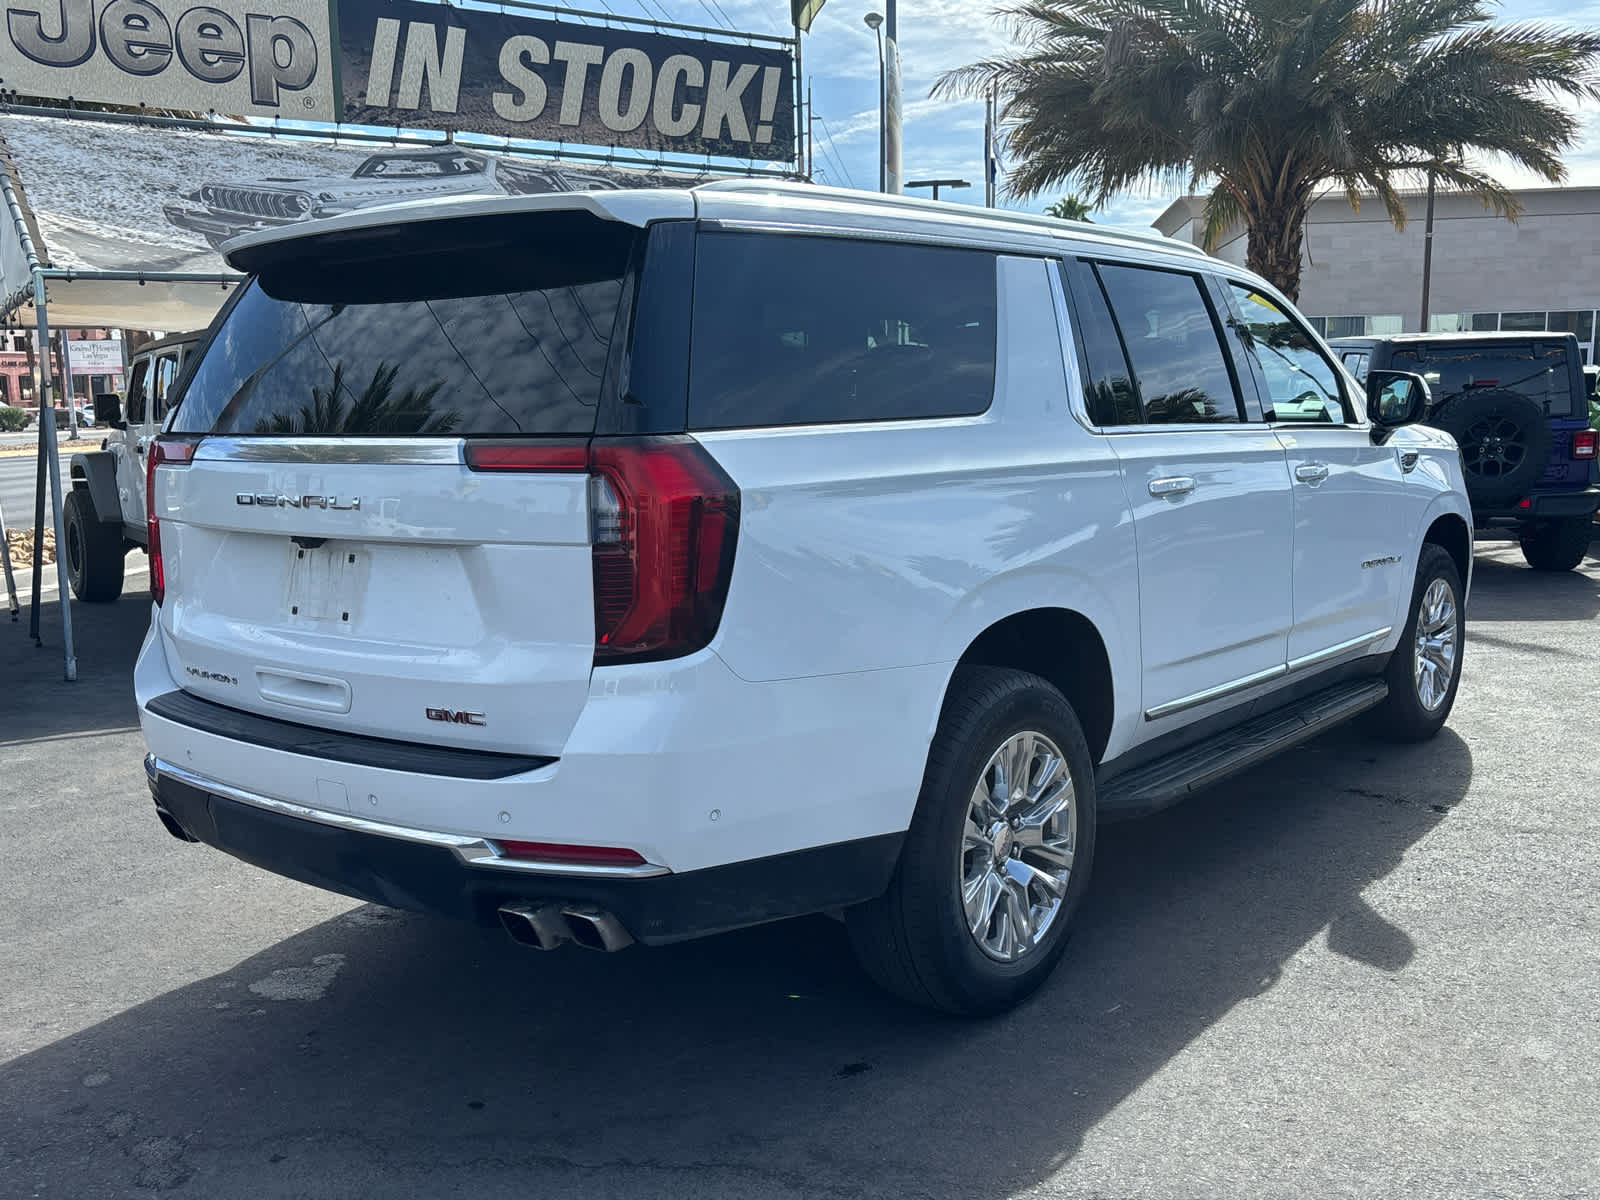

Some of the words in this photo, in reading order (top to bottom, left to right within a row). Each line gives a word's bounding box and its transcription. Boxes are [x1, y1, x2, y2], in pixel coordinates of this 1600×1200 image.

[6, 0, 318, 107] Jeep
[365, 17, 467, 113] IN
[492, 35, 782, 144] STOCK!
[236, 492, 360, 511] DENALI
[1361, 555, 1402, 569] DENALI
[425, 707, 486, 727] GMC
